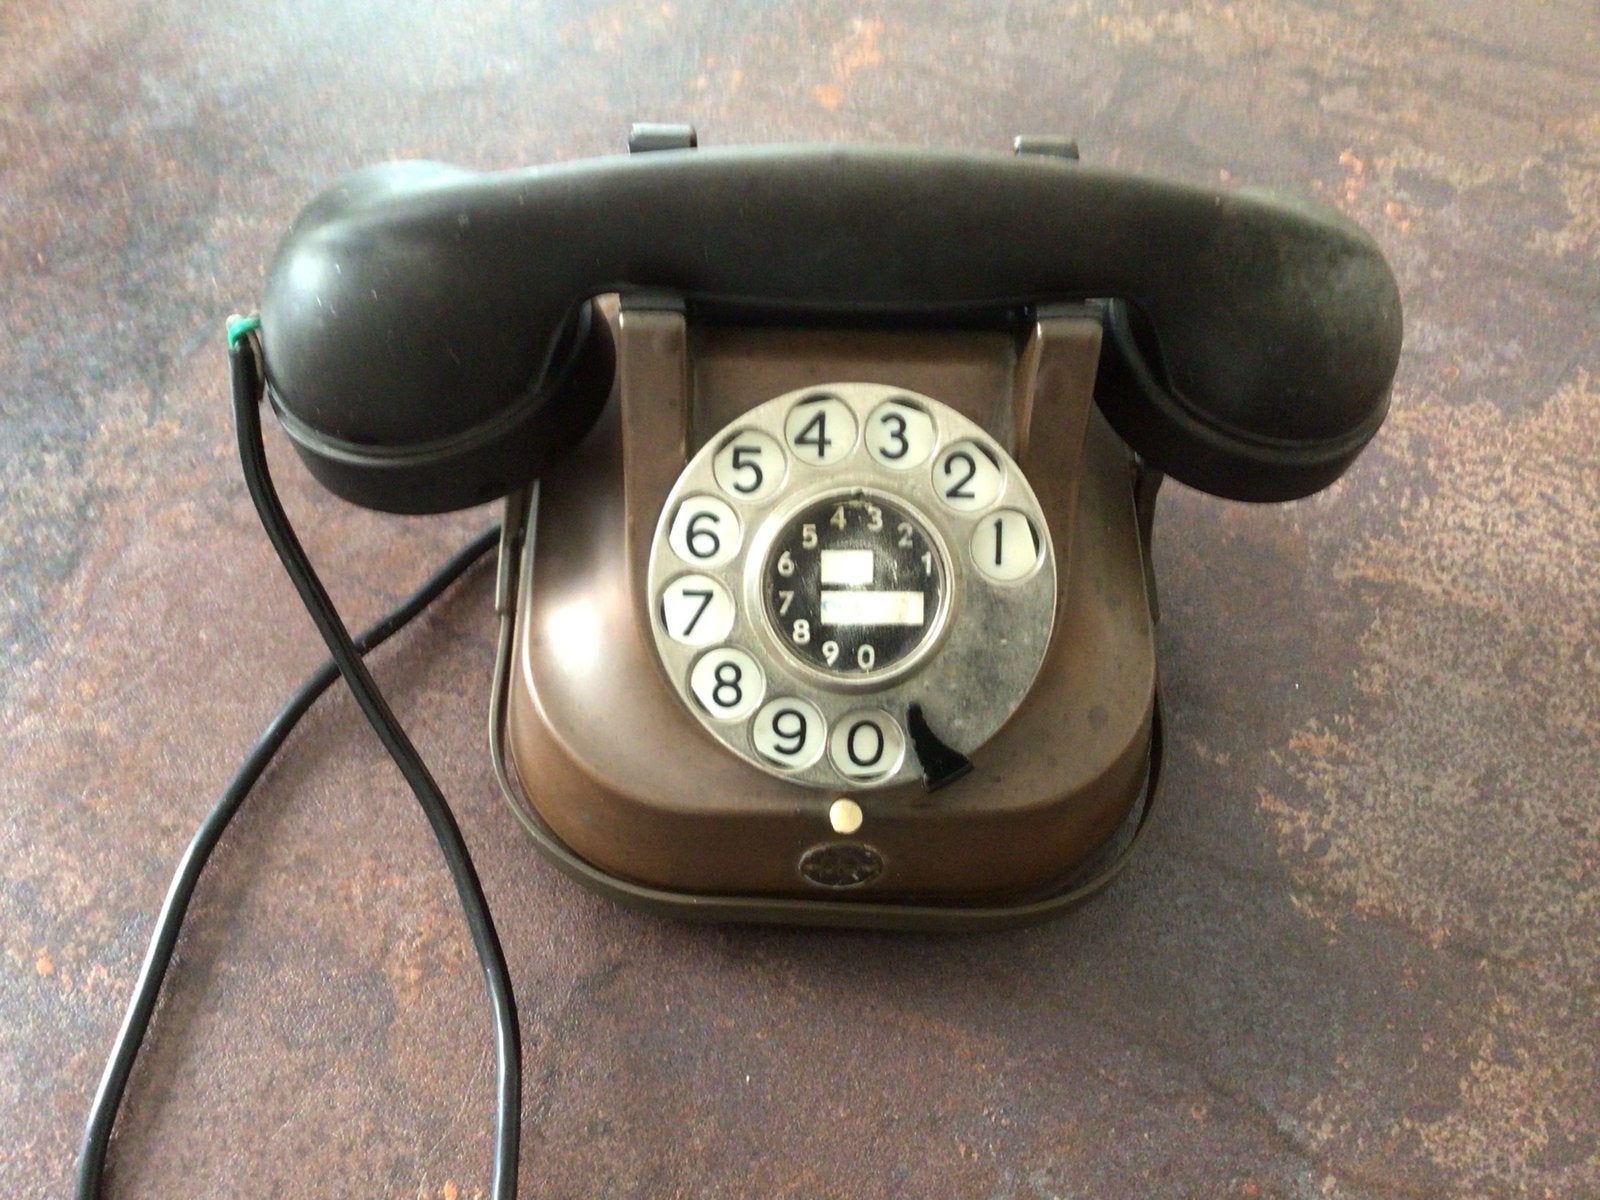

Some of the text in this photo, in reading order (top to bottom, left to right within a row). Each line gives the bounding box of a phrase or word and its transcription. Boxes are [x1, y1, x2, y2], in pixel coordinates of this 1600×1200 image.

[794, 410, 832, 458] 4
[879, 412, 910, 460] 3
[732, 446, 763, 493] 5
[943, 451, 976, 498] 2
[685, 511, 721, 559] 6
[802, 523, 818, 549] 5
[830, 505, 847, 531] 4
[867, 505, 883, 532] 3
[897, 522, 913, 548] 2
[994, 518, 1003, 566] 1
[777, 550, 794, 577] 6
[921, 551, 932, 576] 1
[681, 589, 715, 637] 7
[778, 590, 794, 616] 7
[792, 619, 810, 645] 8
[822, 640, 839, 667] 9
[857, 644, 875, 670] 0
[711, 660, 743, 708] 8
[772, 708, 807, 755] 9
[847, 720, 884, 766] 0
